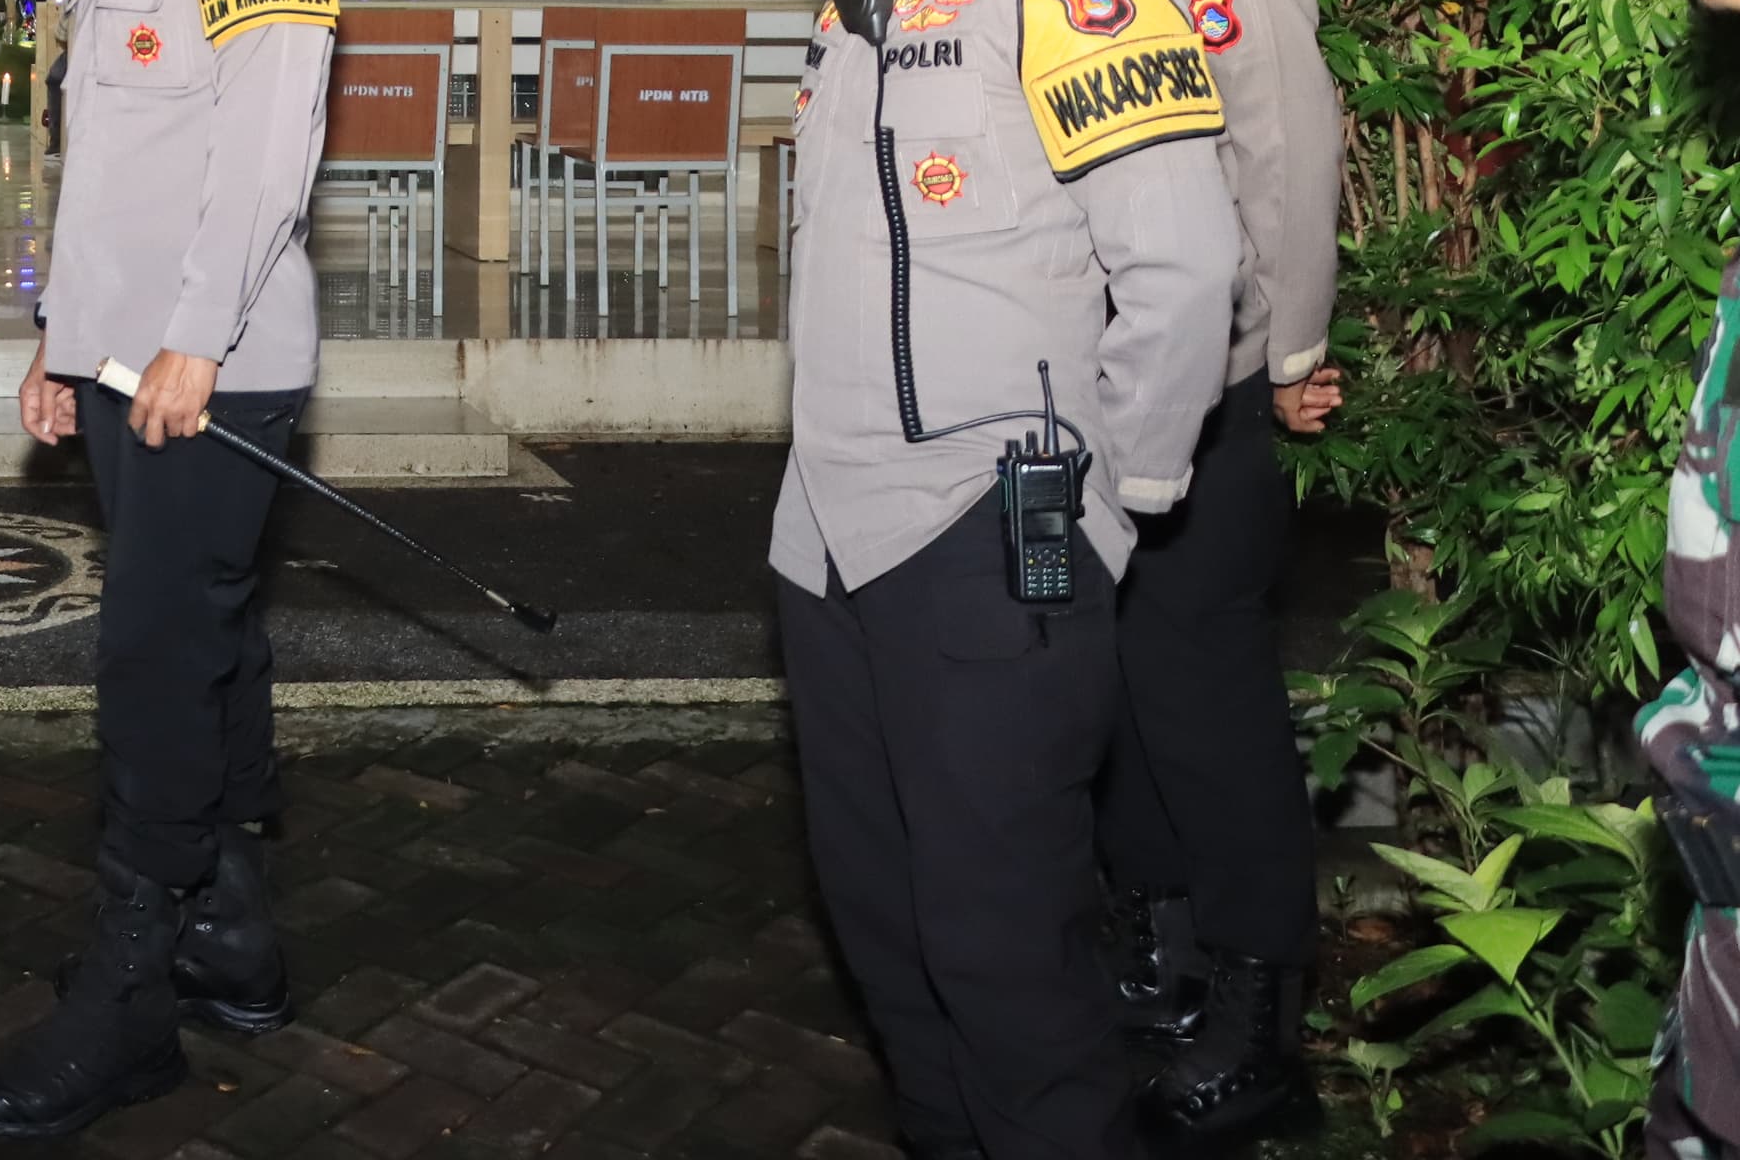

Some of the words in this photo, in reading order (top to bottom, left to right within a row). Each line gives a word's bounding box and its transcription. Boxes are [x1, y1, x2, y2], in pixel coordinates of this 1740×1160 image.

[883, 38, 963, 74] POLRI
[343, 84, 379, 97] IPDN
[383, 85, 414, 97] NTB
[639, 89, 673, 102] IPDN
[680, 89, 710, 102] NTB
[1044, 46, 1213, 138] WAKAOPSRES
